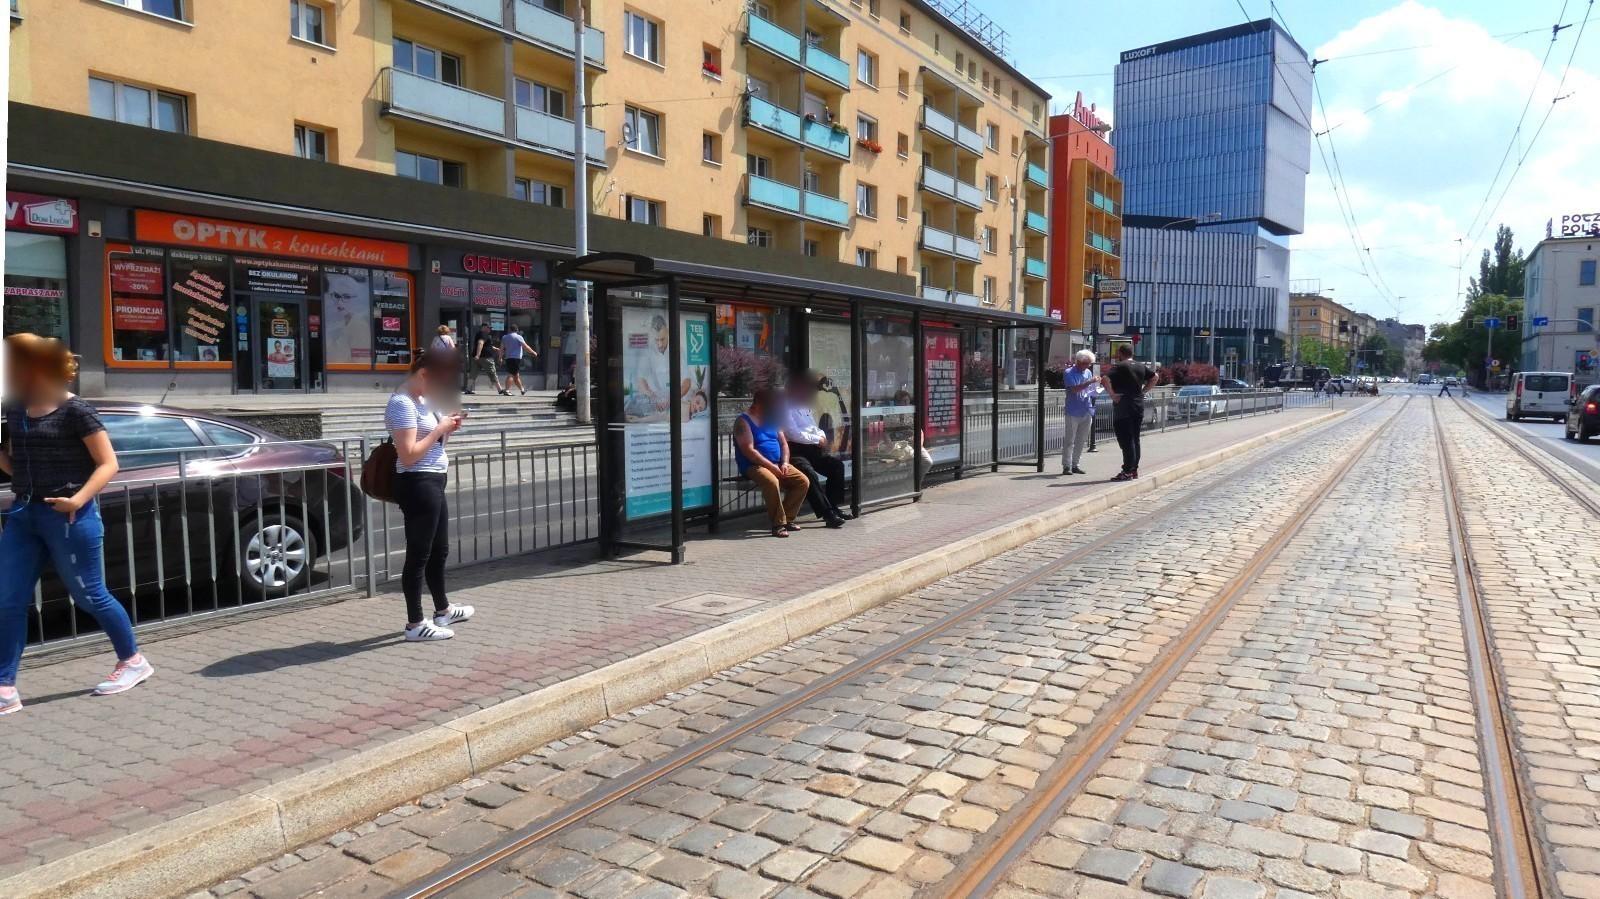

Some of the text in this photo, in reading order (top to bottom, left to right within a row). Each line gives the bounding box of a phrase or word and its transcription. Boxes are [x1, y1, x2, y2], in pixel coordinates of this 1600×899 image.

[1124, 46, 1157, 60] LUXOFT
[1073, 91, 1107, 140] Ami
[172, 219, 385, 262] OPTYK z kontaktami
[463, 253, 533, 279] ORIENT
[248, 269, 261, 277] BEZ
[129, 282, 149, 291] -20%
[5, 287, 65, 299] ZAPRASZAMY
[116, 305, 163, 316] PROMOCJA!
[376, 301, 407, 310] VERSACE
